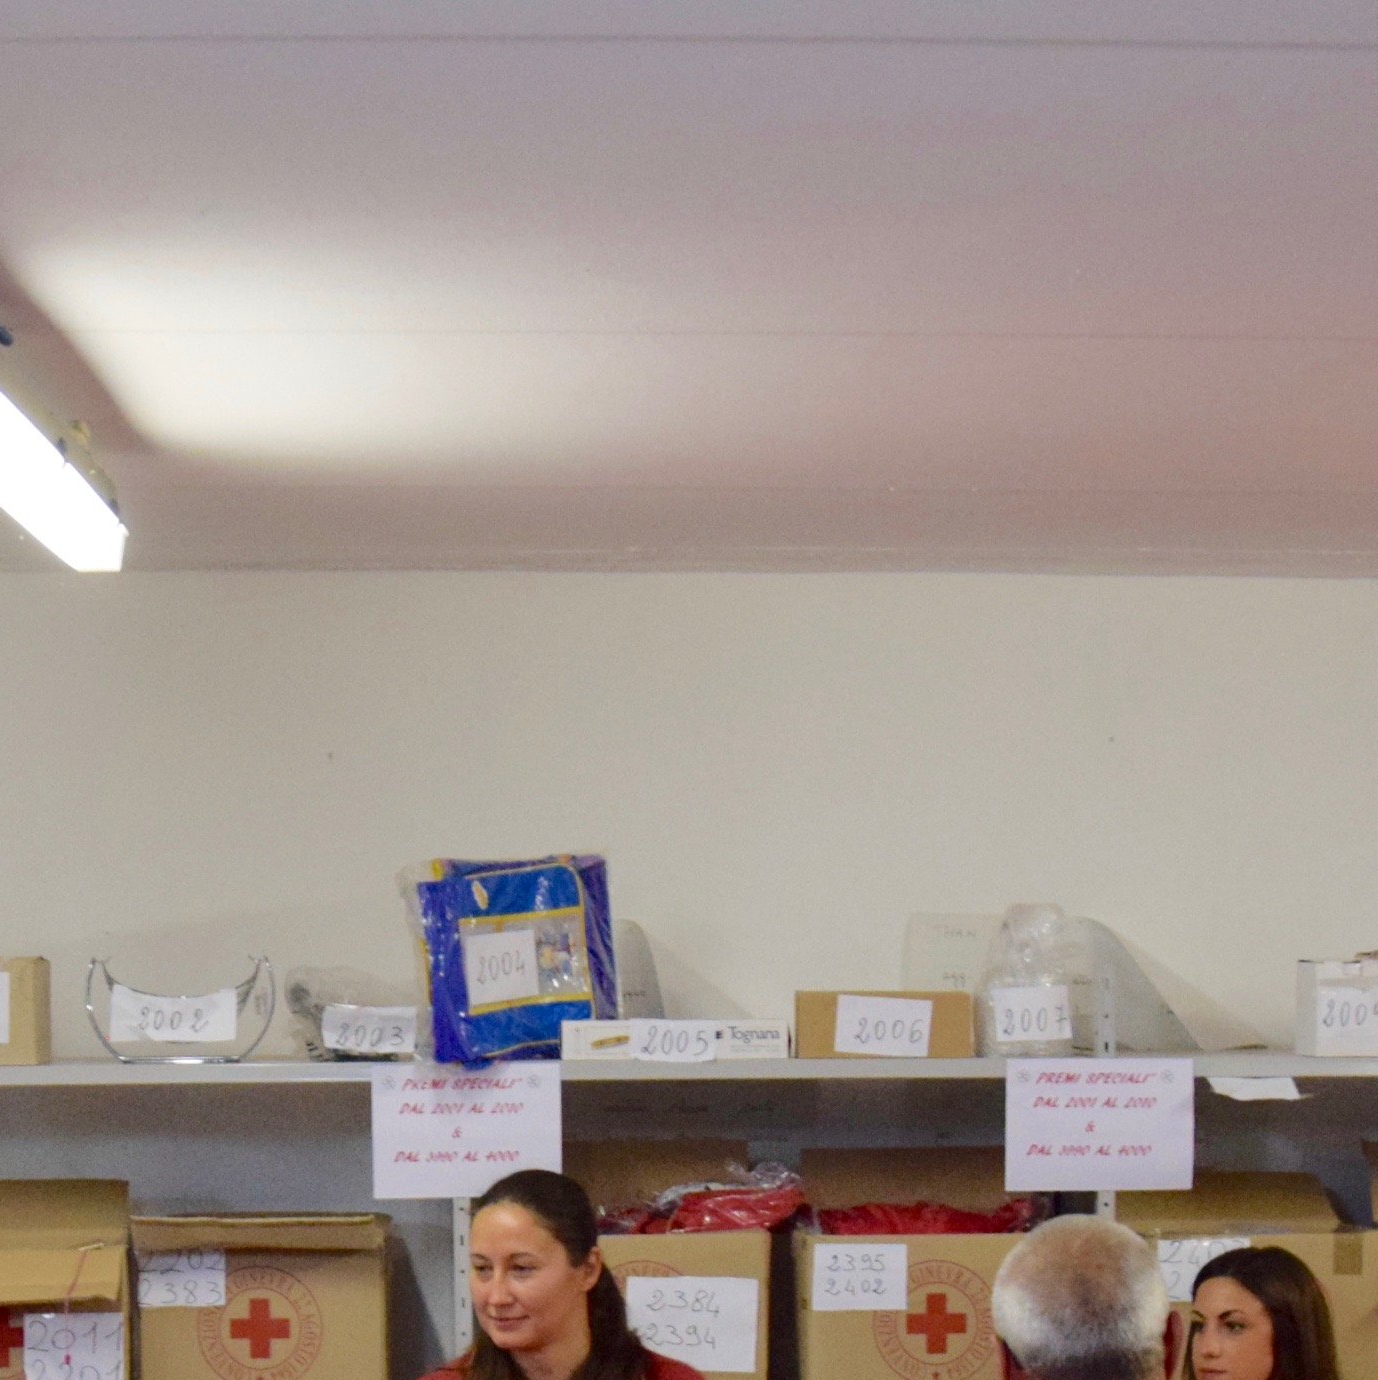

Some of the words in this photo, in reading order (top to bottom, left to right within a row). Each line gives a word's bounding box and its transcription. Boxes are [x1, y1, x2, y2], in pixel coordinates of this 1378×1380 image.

[137, 1007, 210, 1033] 2002
[854, 1017, 923, 1043] 2006
[1003, 1005, 1067, 1036] 2007
[336, 1023, 404, 1047] 2003
[641, 1025, 709, 1056] 2005
[728, 1026, 780, 1043] Tognana
[1036, 1072, 1082, 1084] PREMI
[399, 1103, 425, 1114] DAL
[469, 1103, 485, 1114] AL
[1033, 1097, 1059, 1108] DAL
[1101, 1097, 1118, 1108] AL
[1085, 1120, 1096, 1132] &
[394, 1151, 420, 1162] DAL
[464, 1151, 479, 1162] AL
[1026, 1144, 1053, 1156] DAL
[1094, 1144, 1111, 1156] AL
[827, 1254, 886, 1272] 2395
[138, 1279, 222, 1305] 2383
[824, 1278, 886, 1296] 2402
[646, 1289, 720, 1318] 2384
[27, 1320, 122, 1354] 2011
[646, 1323, 716, 1349] 2394
